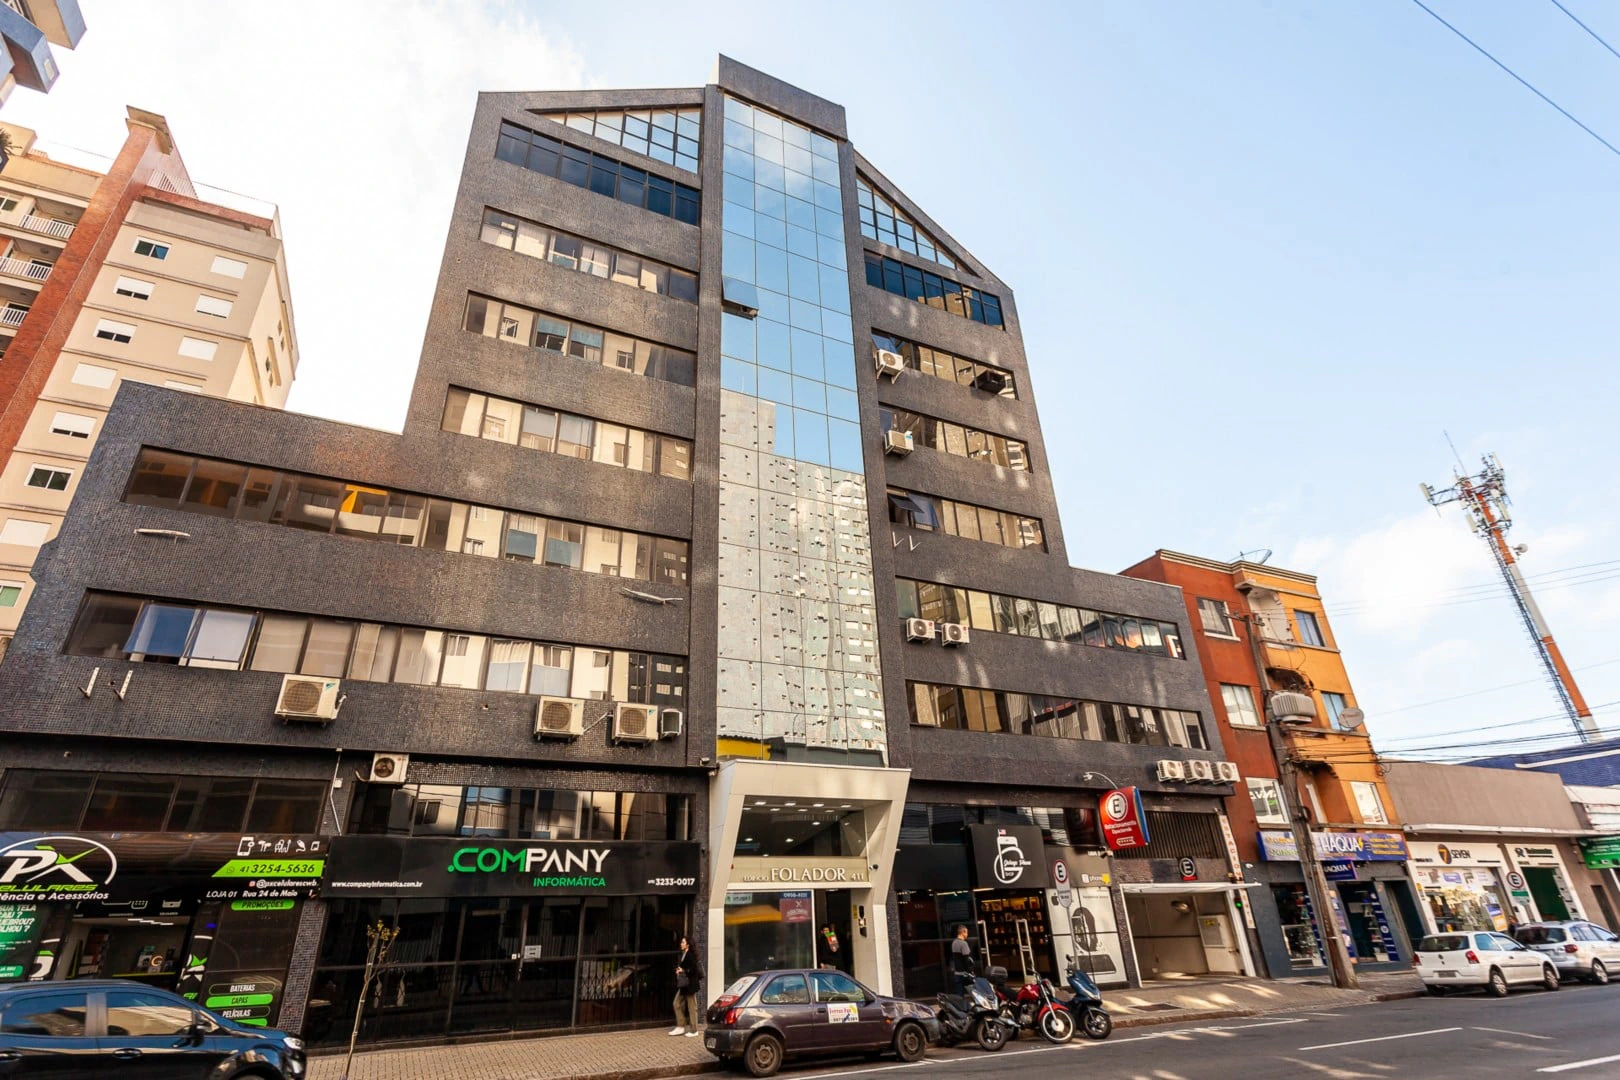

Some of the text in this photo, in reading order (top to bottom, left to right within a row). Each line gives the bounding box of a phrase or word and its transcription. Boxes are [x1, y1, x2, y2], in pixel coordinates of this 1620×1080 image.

[1320, 836, 1360, 852] HAQUA
[1450, 849, 1471, 859] SEVEN
[251, 864, 316, 873] 3254-5636
[1057, 864, 1064, 878] E
[1183, 861, 1193, 874] E
[771, 868, 846, 881] FOLADOR
[851, 873, 864, 881] 411
[1510, 874, 1520, 885] E
[533, 875, 606, 887] INFORMÁTICA
[655, 877, 695, 886] 3233-0017
[48, 891, 110, 900] Acessórios
[206, 890, 298, 898] LOJA 01 Rua 24 de Maio
[229, 984, 256, 992] BATERIAS
[231, 996, 249, 1004] CAPAS
